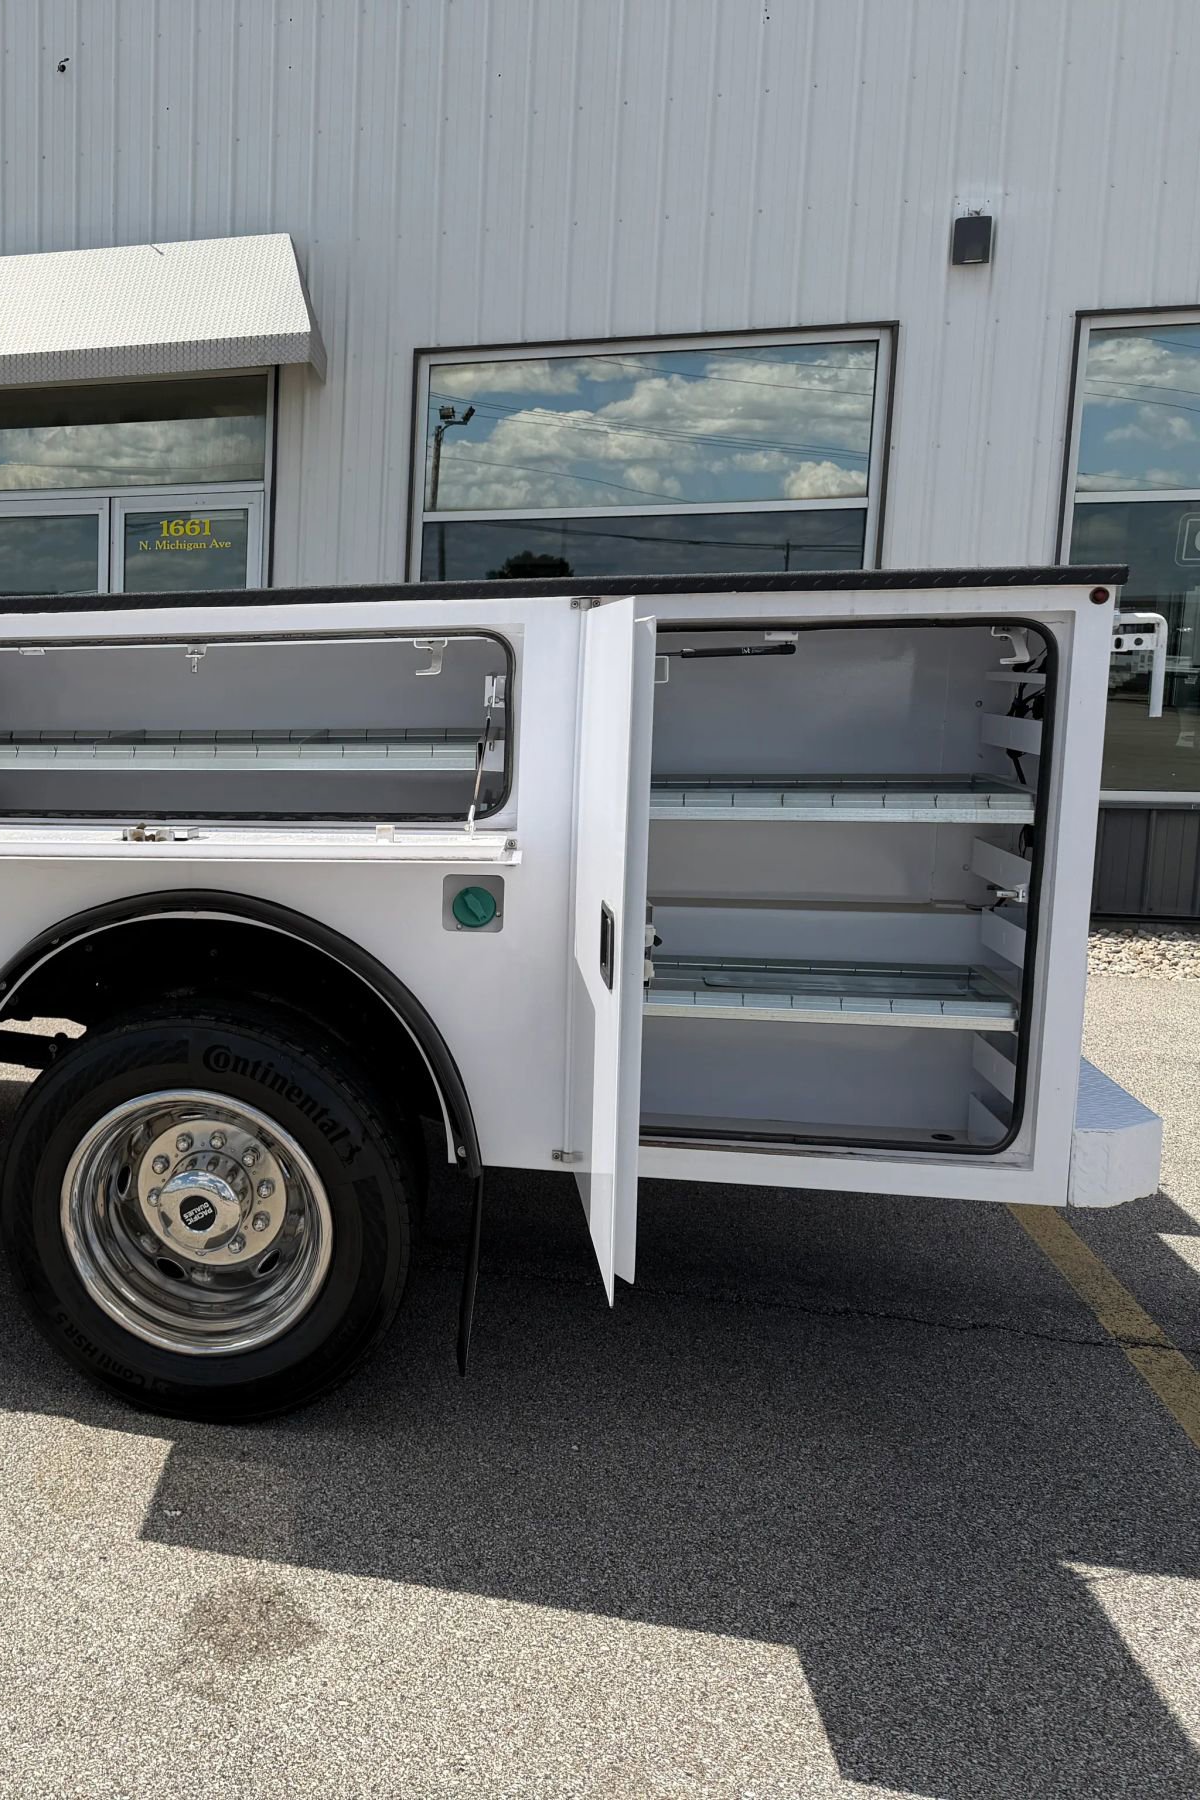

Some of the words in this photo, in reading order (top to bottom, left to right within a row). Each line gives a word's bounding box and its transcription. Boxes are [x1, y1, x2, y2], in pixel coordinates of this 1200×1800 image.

[160, 519, 212, 537] 1661
[139, 540, 151, 550] N.
[155, 540, 206, 551] Michigan
[209, 539, 232, 549] Ave
[202, 1044, 351, 1146] Continental
[185, 1207, 213, 1225] PACIFIC
[64, 1323, 100, 1358] HSR
